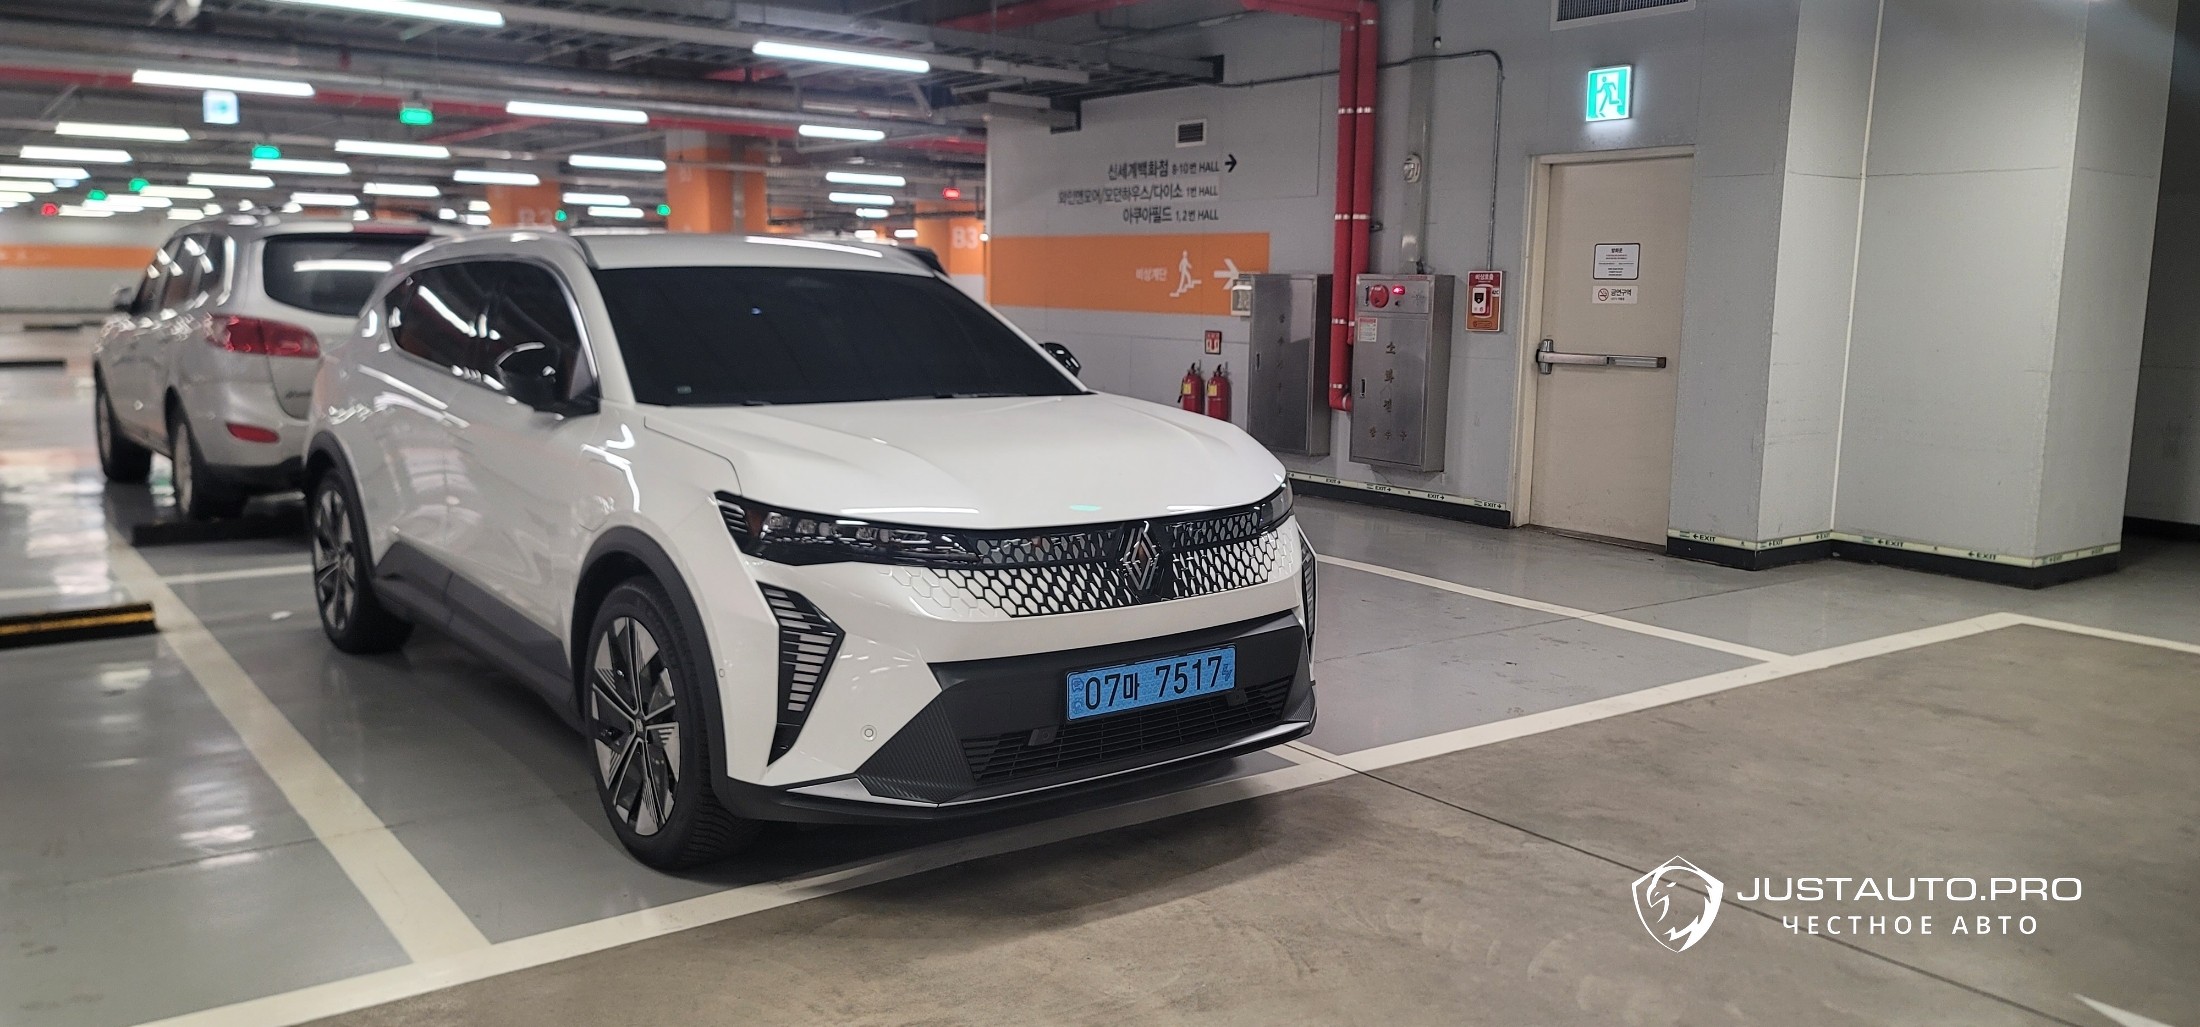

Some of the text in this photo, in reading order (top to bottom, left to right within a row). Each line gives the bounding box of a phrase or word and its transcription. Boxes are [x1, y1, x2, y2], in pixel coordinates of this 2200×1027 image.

[1108, 160, 1169, 181] 신세계백화점
[1199, 161, 1219, 173] HALL
[1199, 185, 1219, 196] HALL
[1123, 205, 1173, 225] 아쿠아필드
[1198, 209, 1219, 220] HALL
[952, 226, 978, 249] B3
[1699, 534, 1716, 542] EXIT
[1772, 539, 1783, 547] EXIT
[1885, 540, 1904, 548] EXIT
[1976, 552, 1996, 560] EXIT
[1085, 655, 1222, 710] 07마 7517
